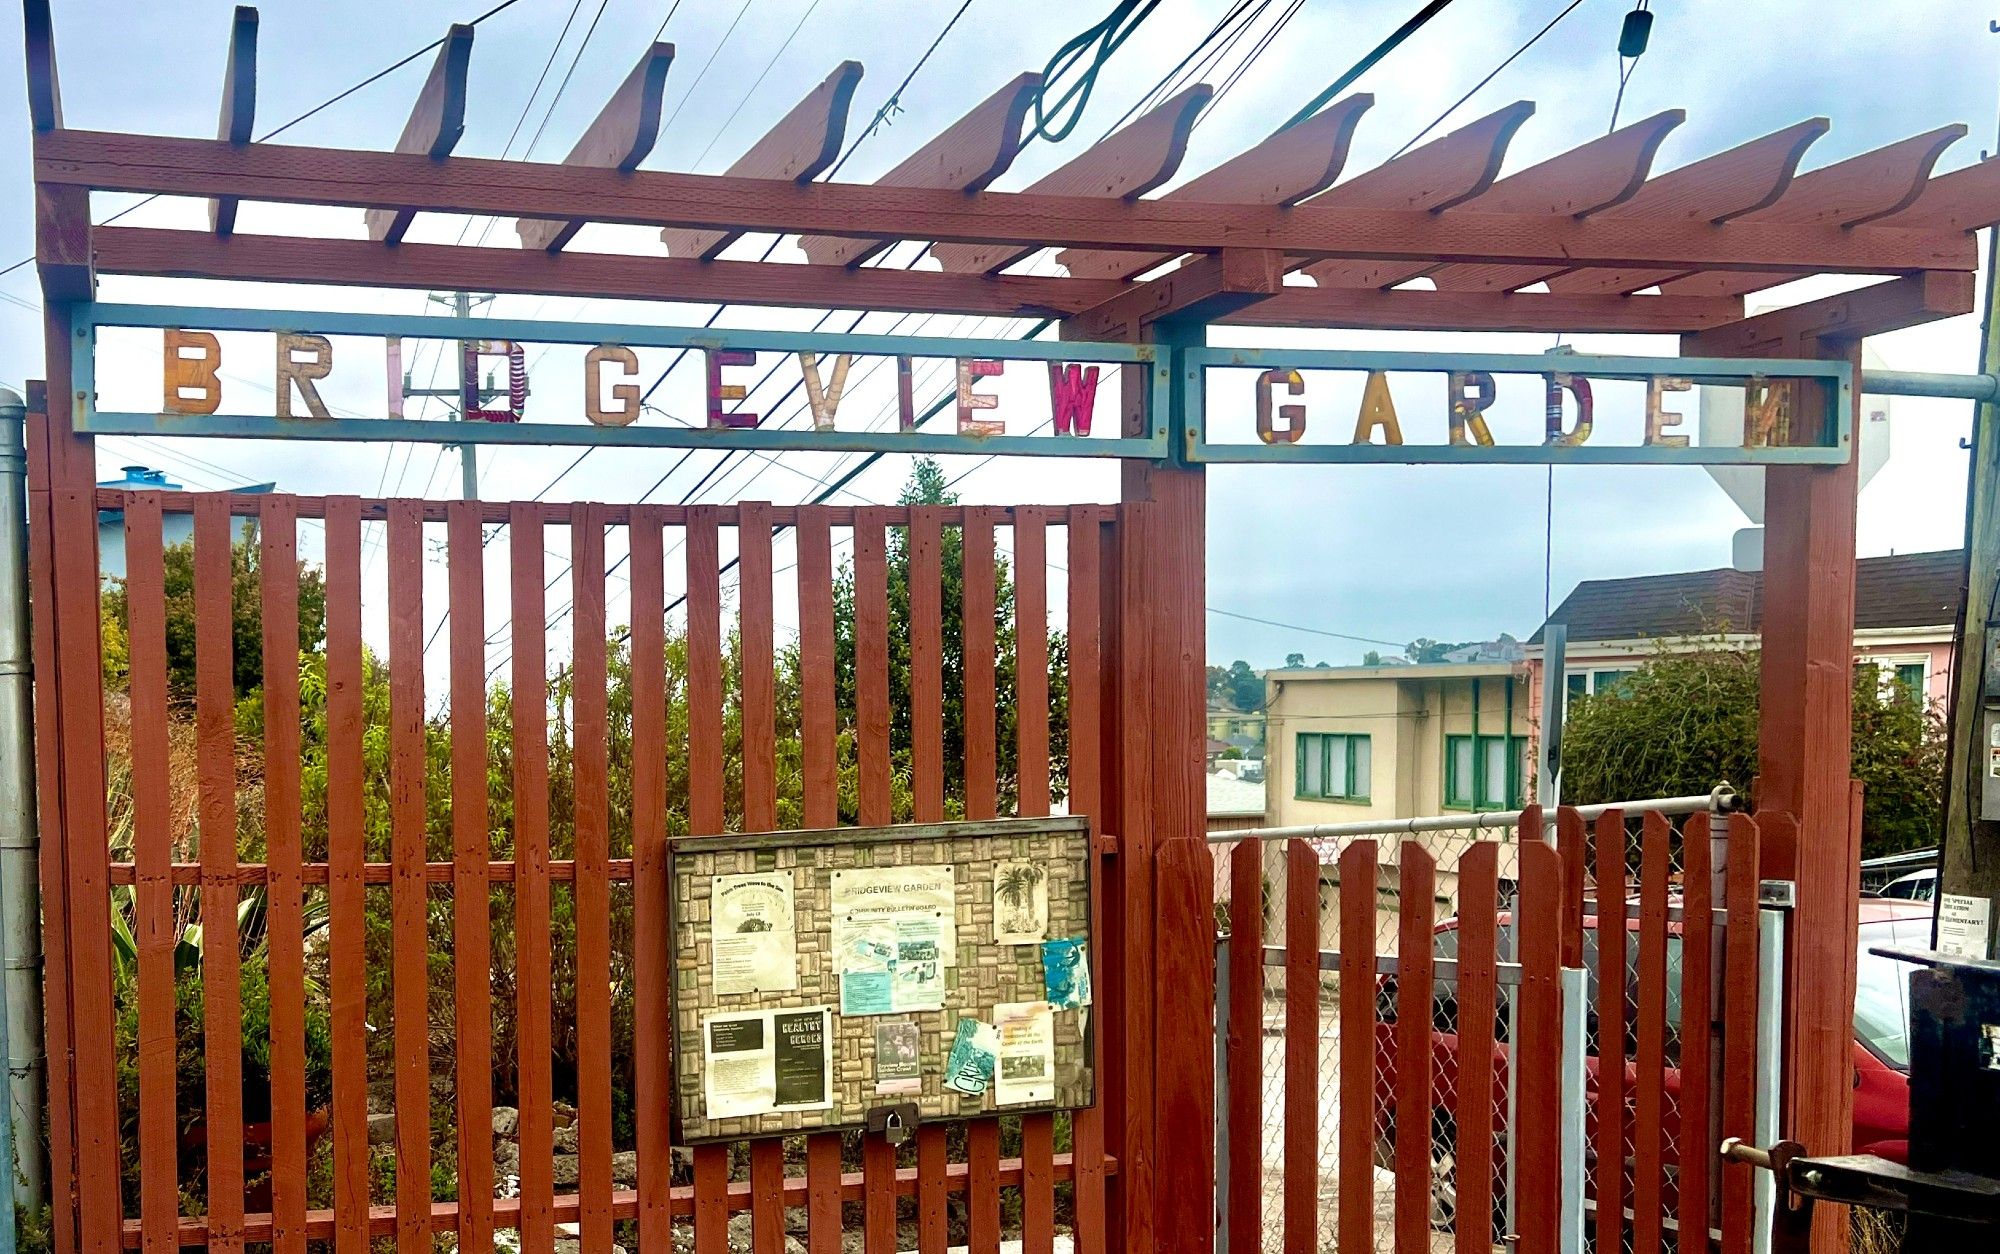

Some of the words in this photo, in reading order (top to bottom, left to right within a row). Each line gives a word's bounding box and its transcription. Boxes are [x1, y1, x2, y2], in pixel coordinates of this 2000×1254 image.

[163, 328, 1100, 437] BRIDGEVIEW
[1256, 370, 1791, 448] GARDEN
[845, 885, 901, 896] BRIDGEVIEW
[903, 883, 941, 893] GARDEN
[886, 905, 915, 913] BULLETIN
[915, 904, 937, 912] BOARD
[782, 1020, 822, 1034] HEALTHY
